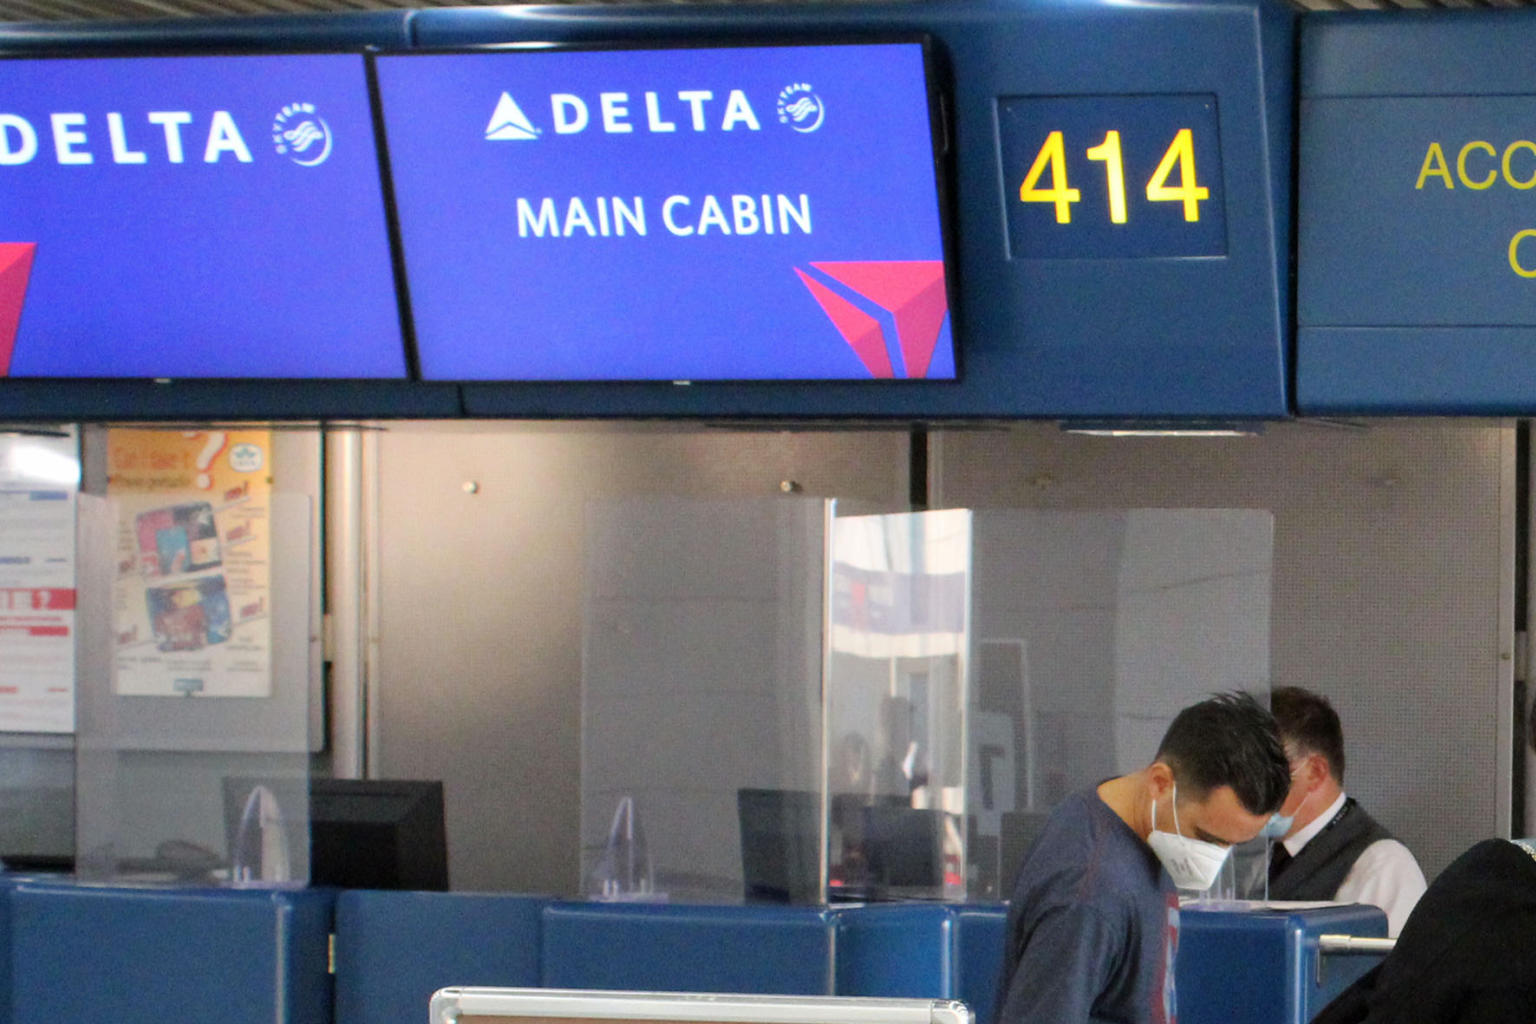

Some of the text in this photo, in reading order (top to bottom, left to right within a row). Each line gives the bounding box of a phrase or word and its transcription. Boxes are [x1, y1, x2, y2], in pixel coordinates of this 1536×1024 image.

[551, 90, 760, 134] DELTA
[0, 111, 253, 166] DELTA
[1019, 128, 1209, 223] 414
[517, 194, 812, 239] MAIN CABIN
